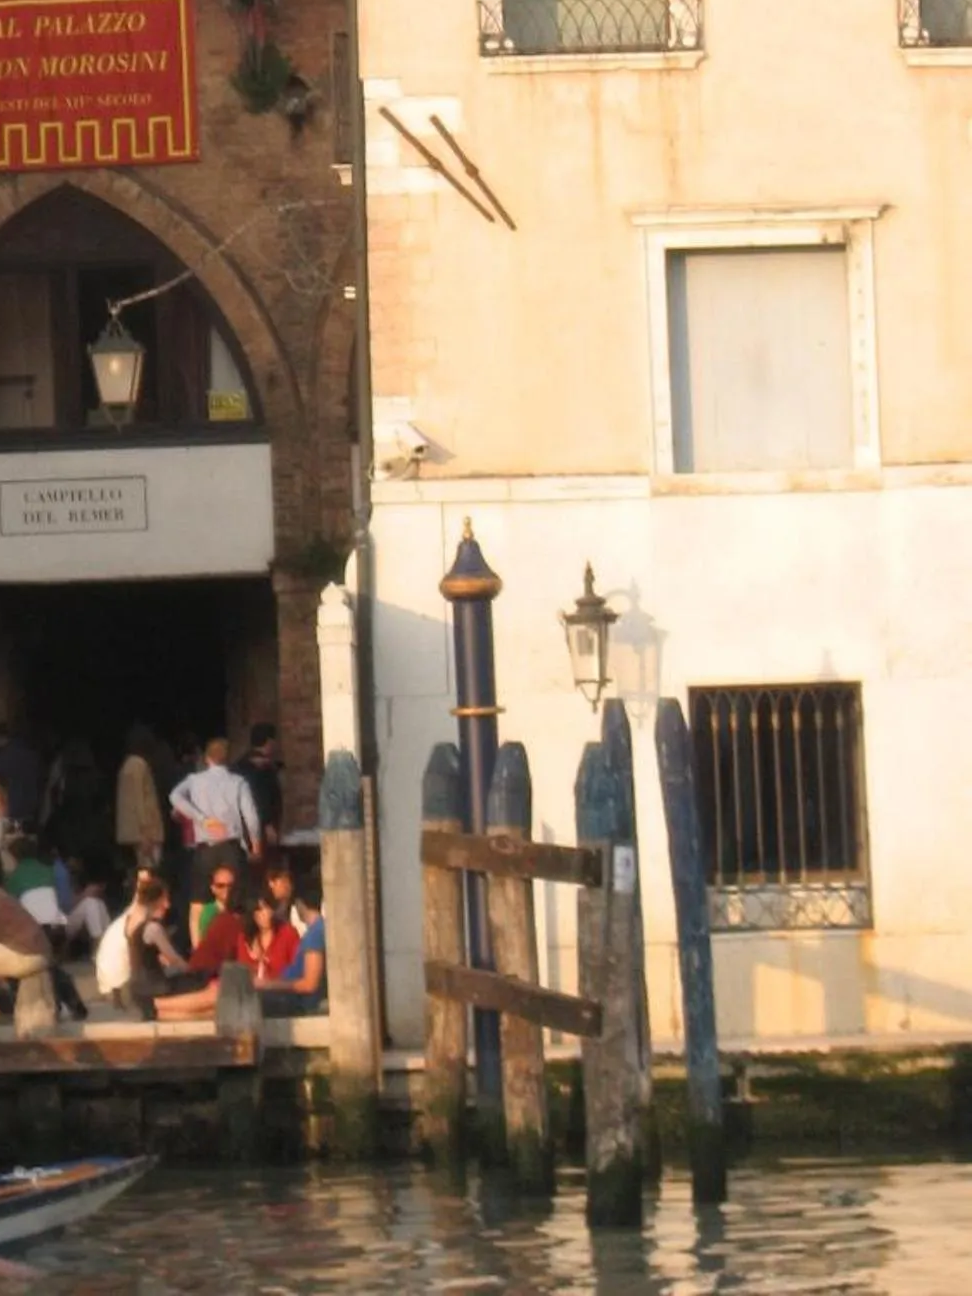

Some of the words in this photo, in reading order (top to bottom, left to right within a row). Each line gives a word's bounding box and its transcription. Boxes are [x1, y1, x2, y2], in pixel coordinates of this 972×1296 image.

[33, 11, 146, 37] PALAZZO
[38, 50, 169, 79] MOROSINI
[23, 487, 123, 505] CAMPIELLO
[22, 510, 58, 525] DEL
[68, 507, 124, 523] REMER
